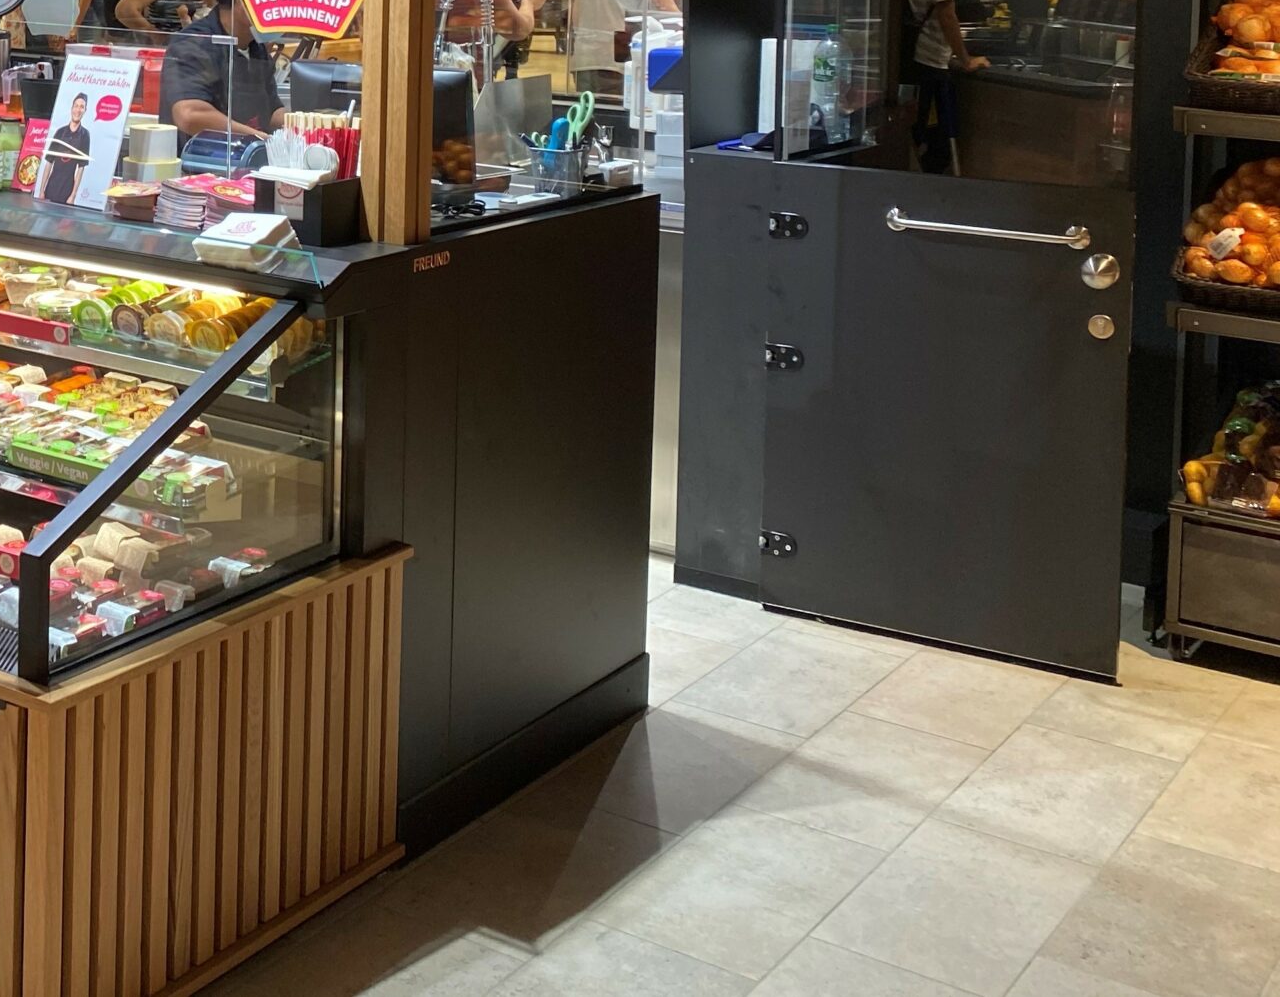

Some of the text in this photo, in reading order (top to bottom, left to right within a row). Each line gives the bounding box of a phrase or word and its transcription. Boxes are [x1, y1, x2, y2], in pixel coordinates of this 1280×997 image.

[263, 6, 340, 28] GEWINNEN!
[413, 250, 451, 273] FREUND
[16, 450, 51, 471] Veggie
[56, 461, 89, 481] Vegan
